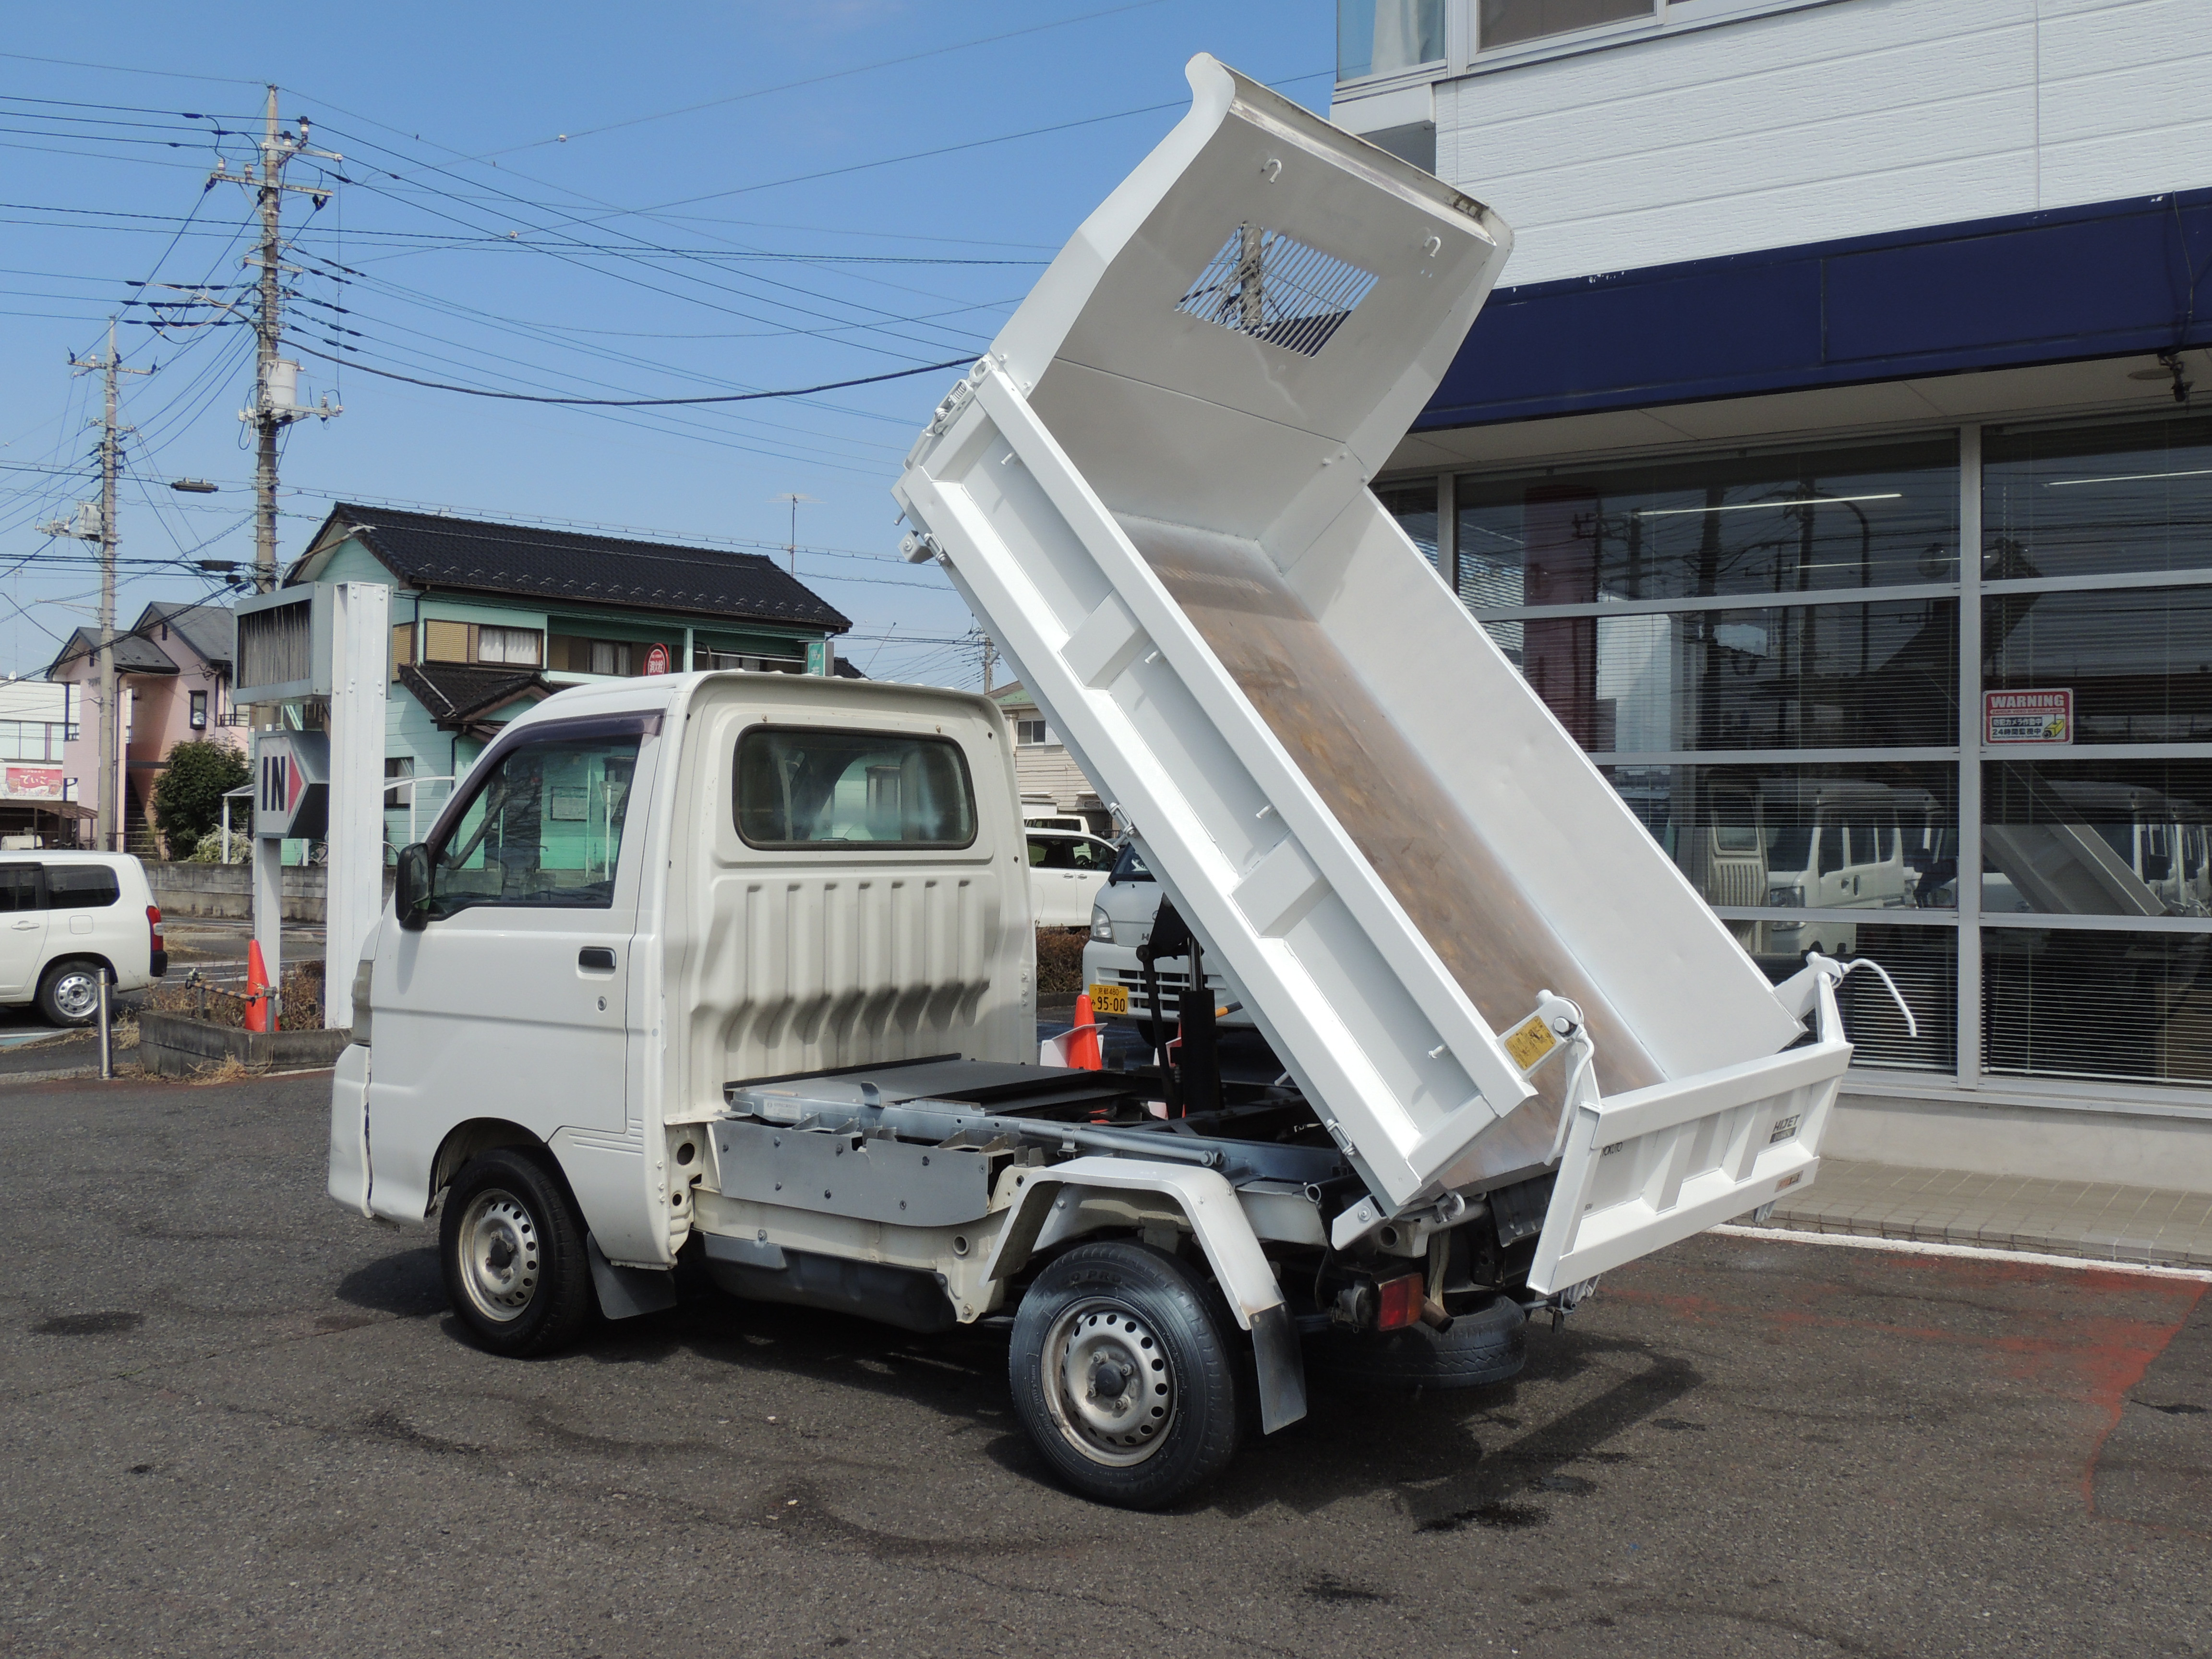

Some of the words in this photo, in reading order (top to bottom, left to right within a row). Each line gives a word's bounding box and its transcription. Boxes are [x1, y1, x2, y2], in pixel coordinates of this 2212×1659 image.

[1991, 695, 2064, 708] WARNING
[1993, 718, 2042, 726] 防犯カメラ作動中
[262, 756, 286, 811] IN
[1097, 996, 1125, 1012] 95-00
[1772, 1114, 1801, 1133] HIJET
